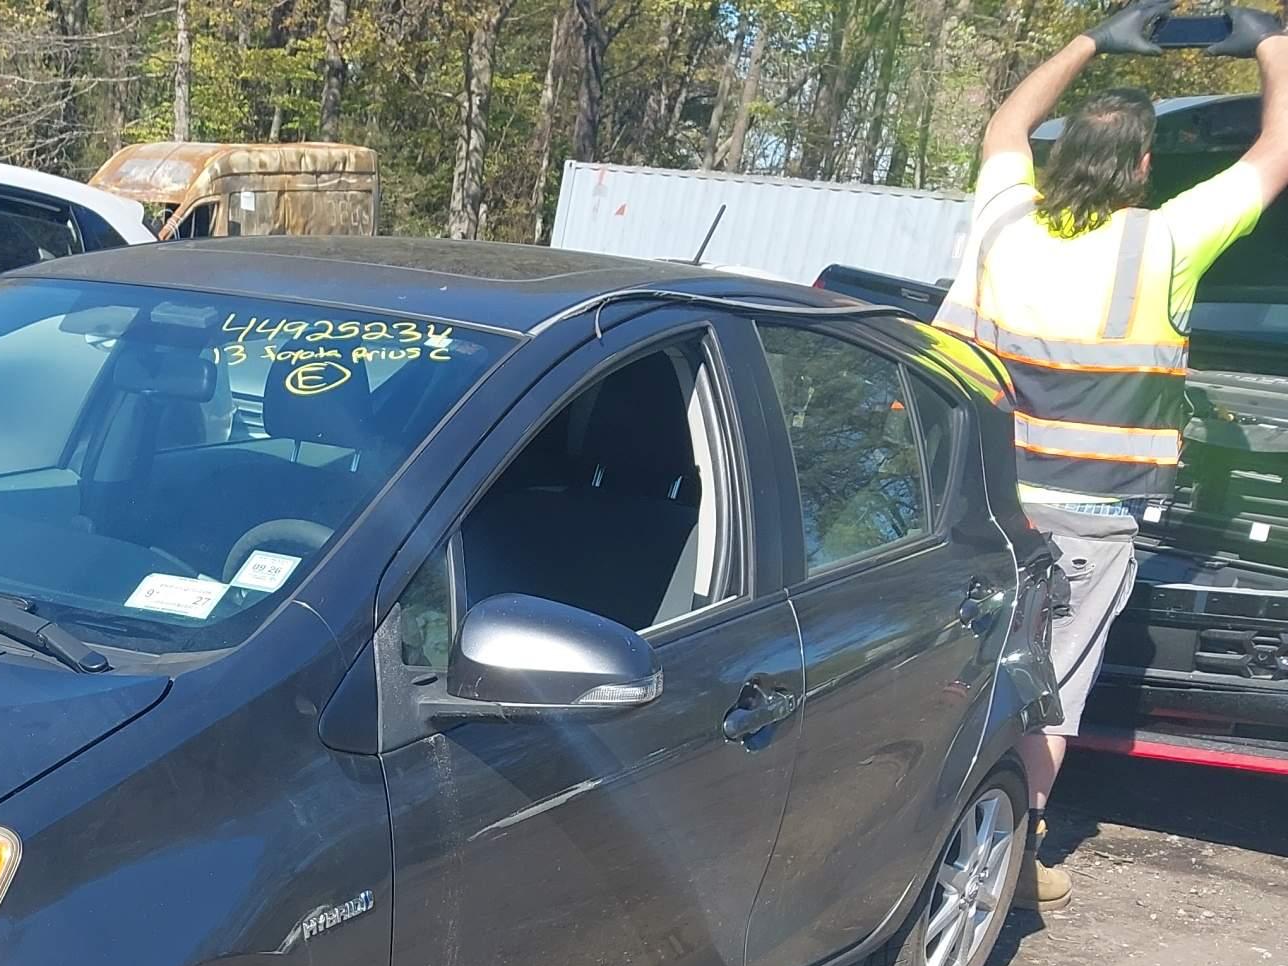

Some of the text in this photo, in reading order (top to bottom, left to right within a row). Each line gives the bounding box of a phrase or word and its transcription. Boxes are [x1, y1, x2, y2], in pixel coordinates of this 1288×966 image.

[213, 346, 247, 365] 13
[297, 365, 327, 389] E
[302, 890, 374, 941] HYBRID
